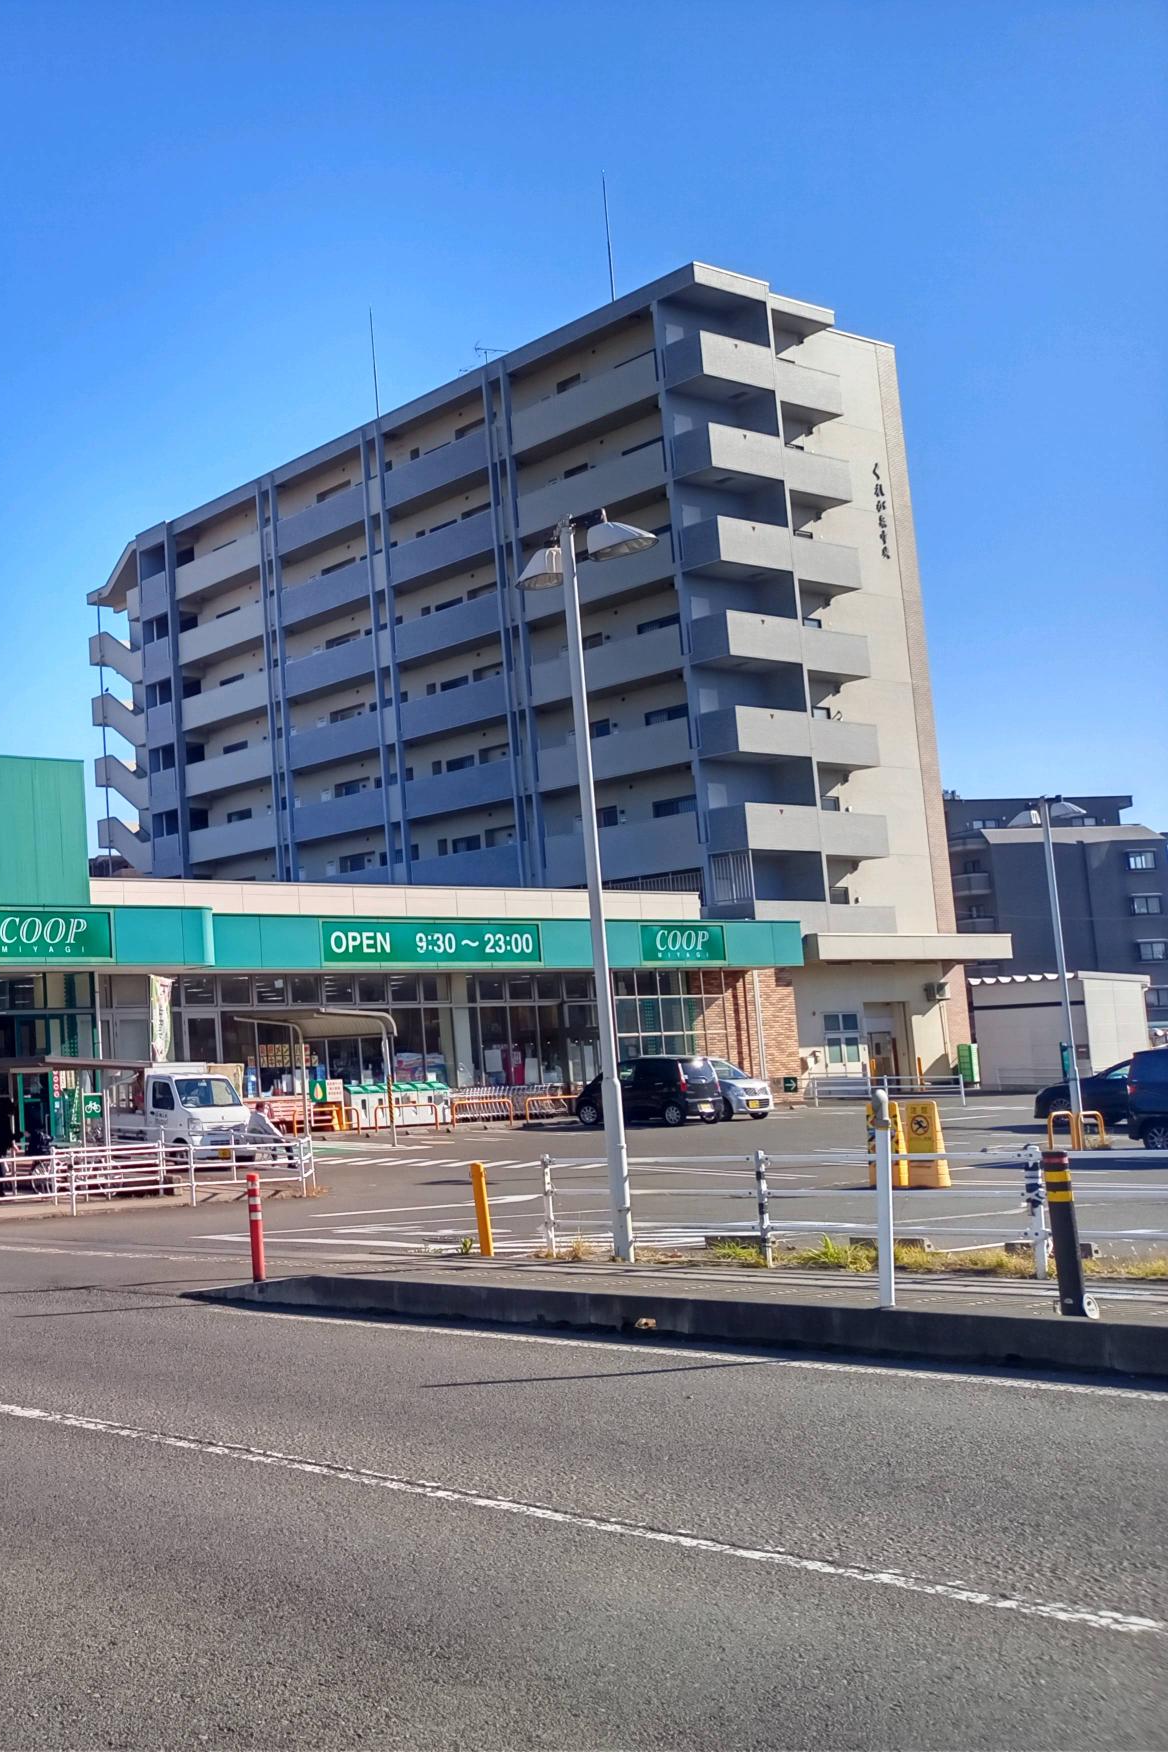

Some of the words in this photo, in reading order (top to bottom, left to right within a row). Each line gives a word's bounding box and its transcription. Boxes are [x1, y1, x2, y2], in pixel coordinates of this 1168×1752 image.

[0, 916, 88, 944] COOP
[655, 929, 710, 951] COOP
[1, 945, 85, 953] MIYAGI
[330, 930, 391, 953] OPEN
[415, 932, 456, 953] 9:30
[484, 933, 533, 954] 23:00
